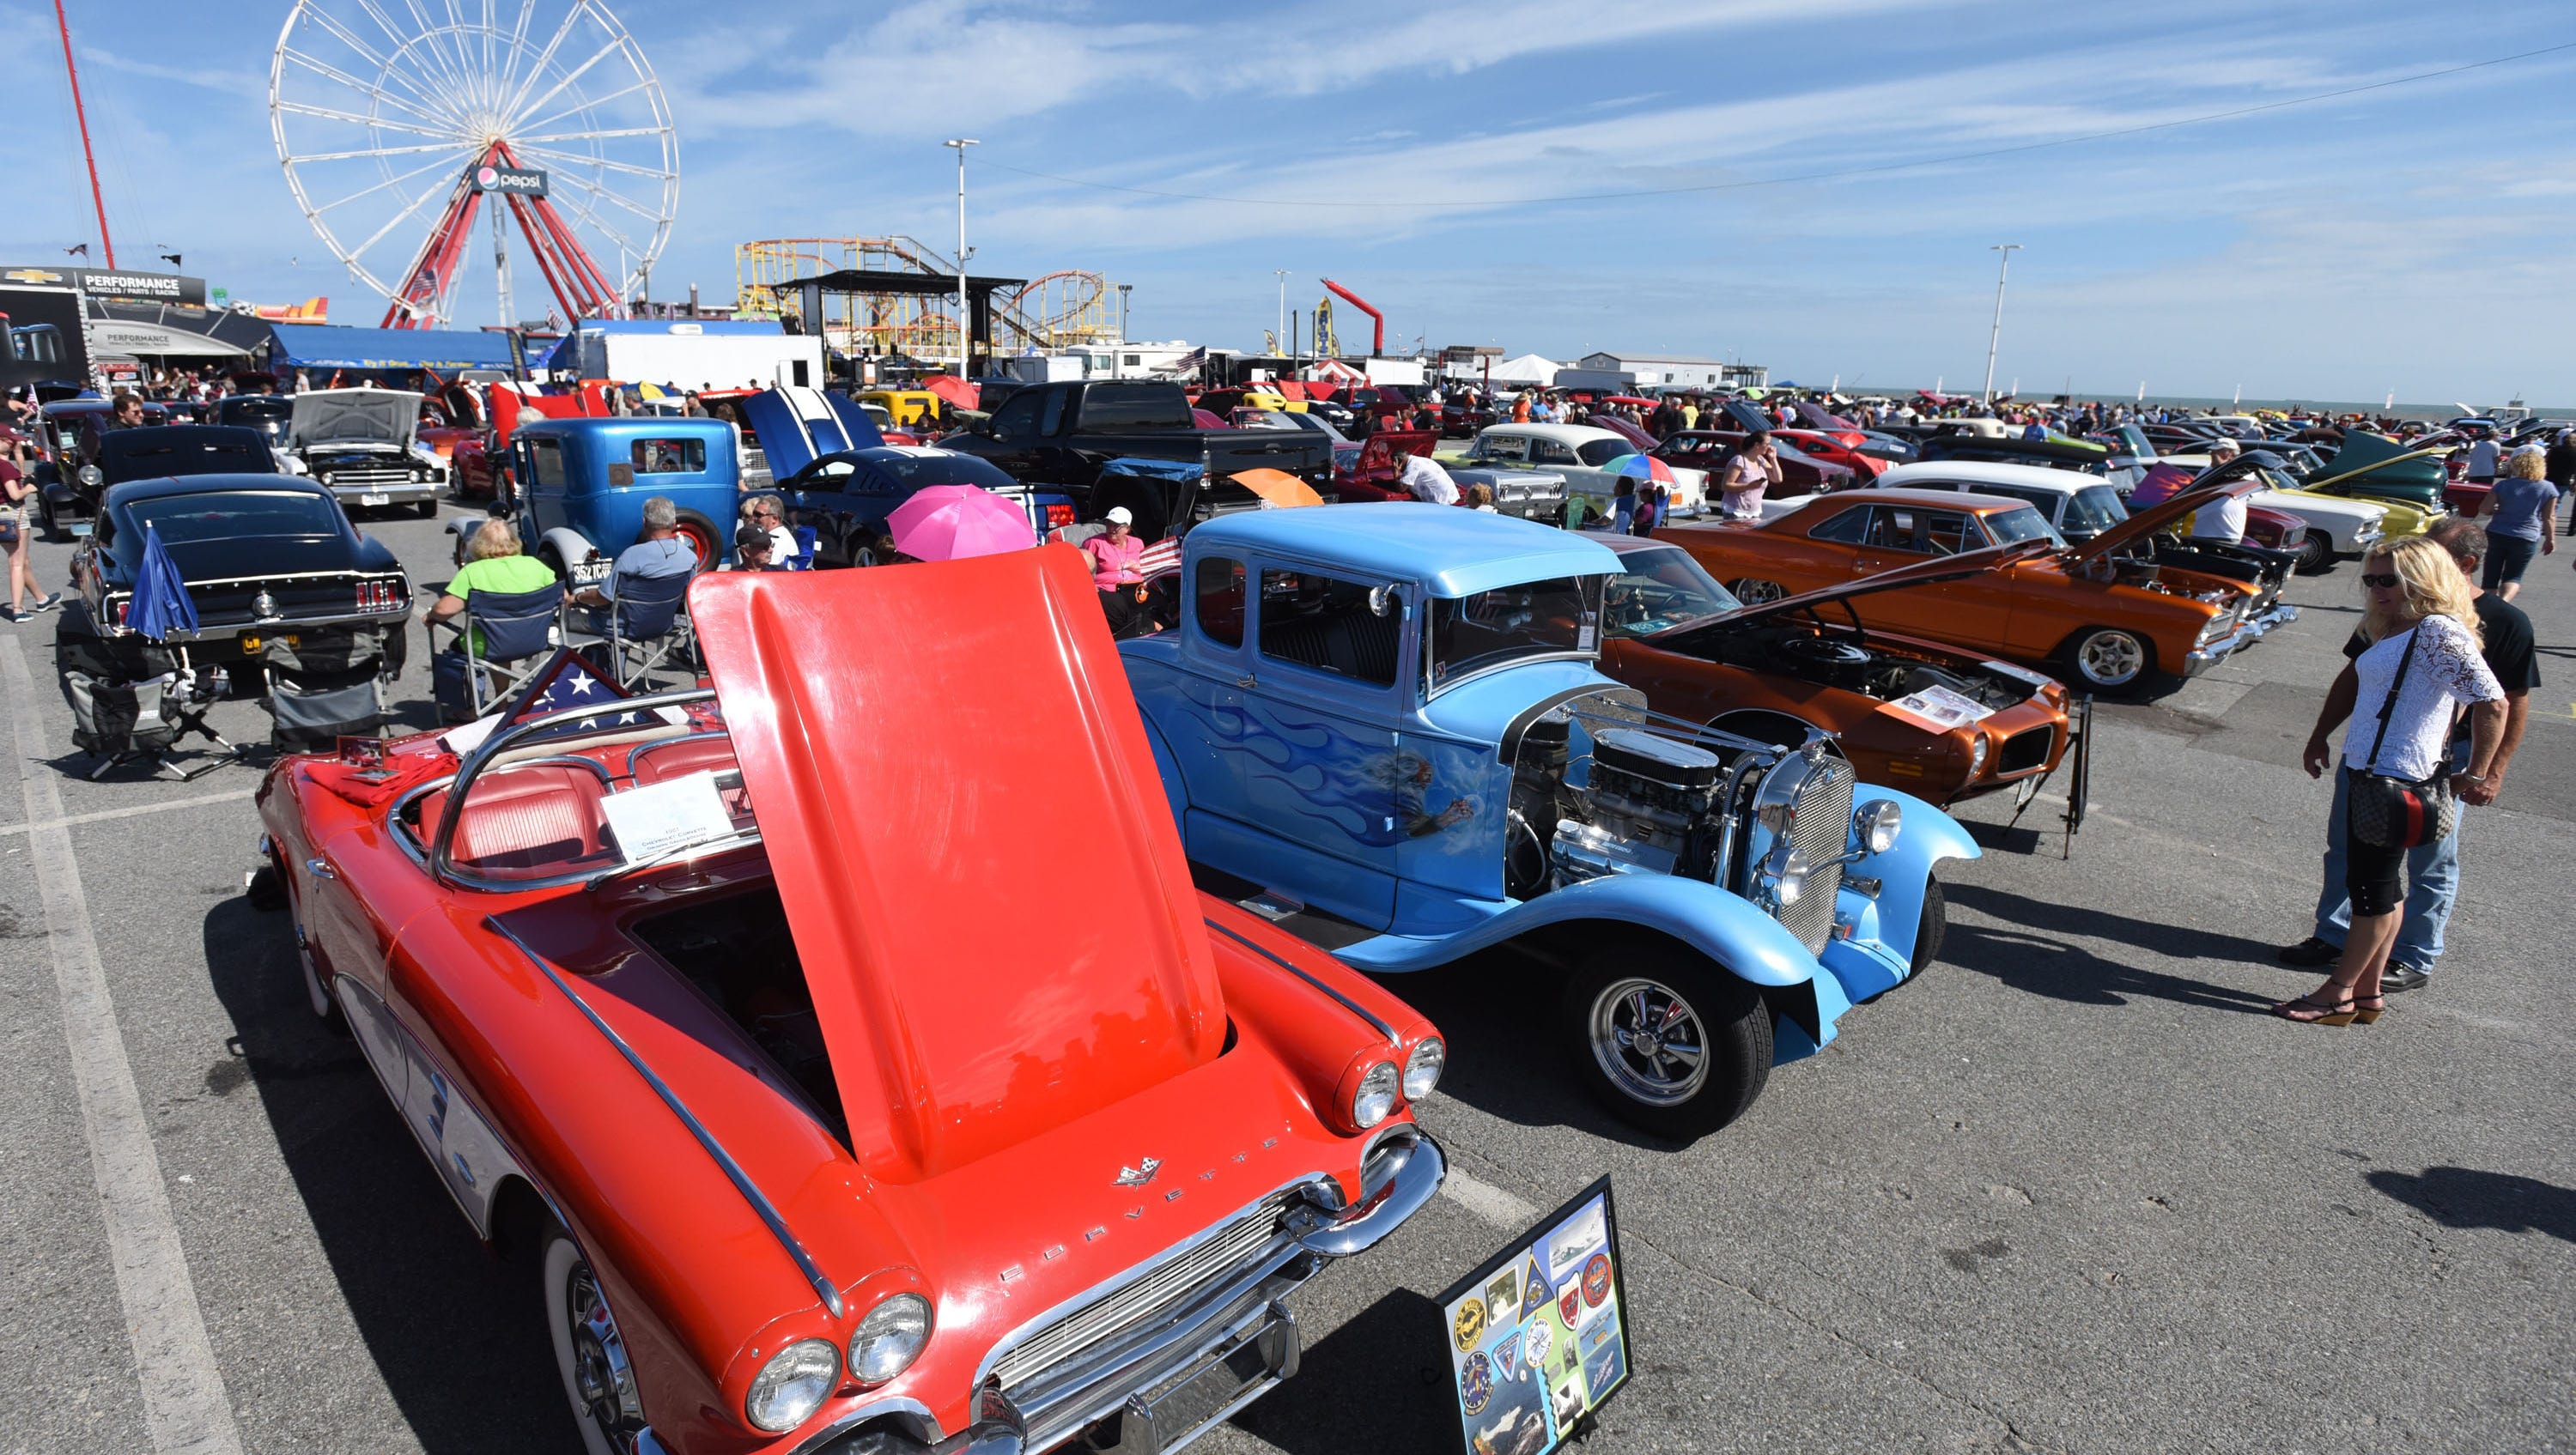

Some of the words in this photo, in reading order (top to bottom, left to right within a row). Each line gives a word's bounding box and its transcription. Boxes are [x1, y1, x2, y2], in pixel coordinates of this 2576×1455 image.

[501, 175, 541, 189] pepsi
[85, 275, 179, 290] PERFORMANCE
[88, 286, 122, 294] VEHICLES
[107, 334, 170, 343] PERFORMANCE
[1000, 1137, 1278, 1282] CORVETTE
[1534, 1319, 1549, 1327] NAVY
